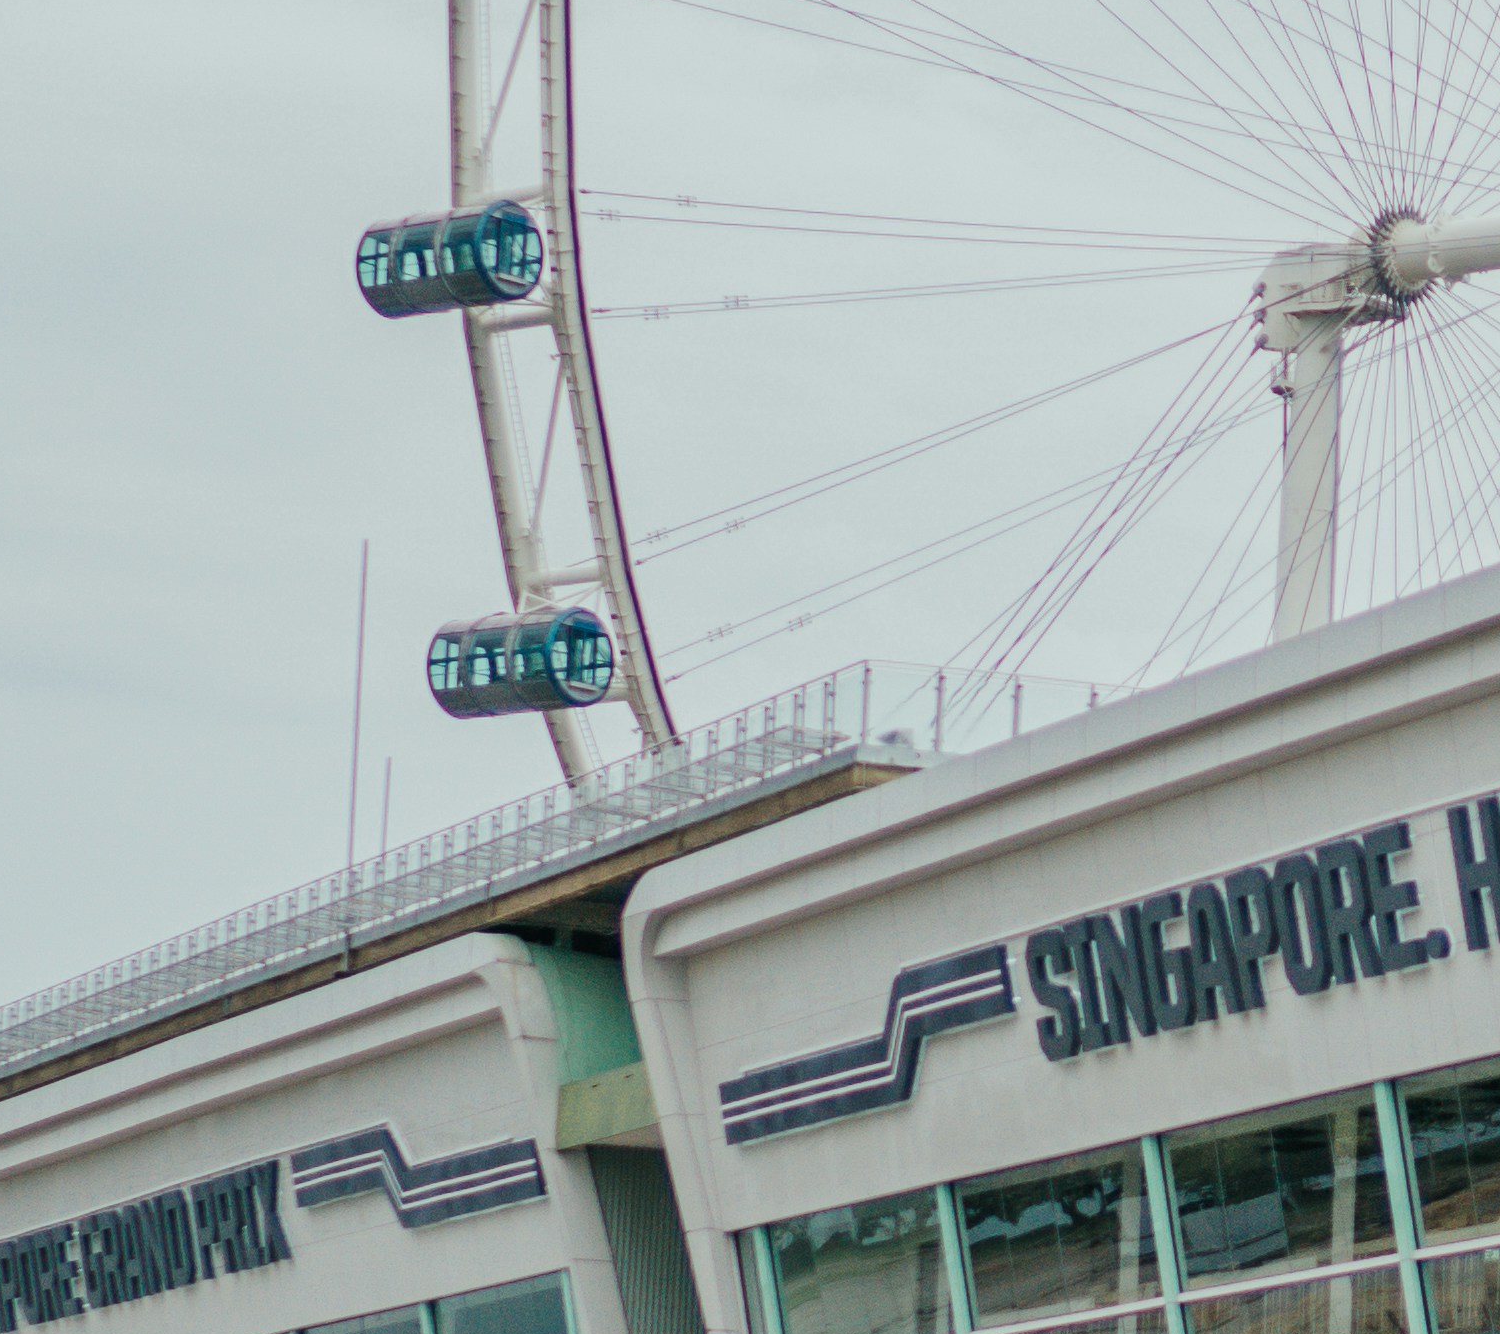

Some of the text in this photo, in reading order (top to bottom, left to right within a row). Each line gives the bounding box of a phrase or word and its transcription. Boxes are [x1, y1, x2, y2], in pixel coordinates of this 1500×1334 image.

[1025, 821, 1451, 1062] SINGAPORE.
[77, 1187, 198, 1309] GRAND
[190, 1158, 293, 1281] PRIX
